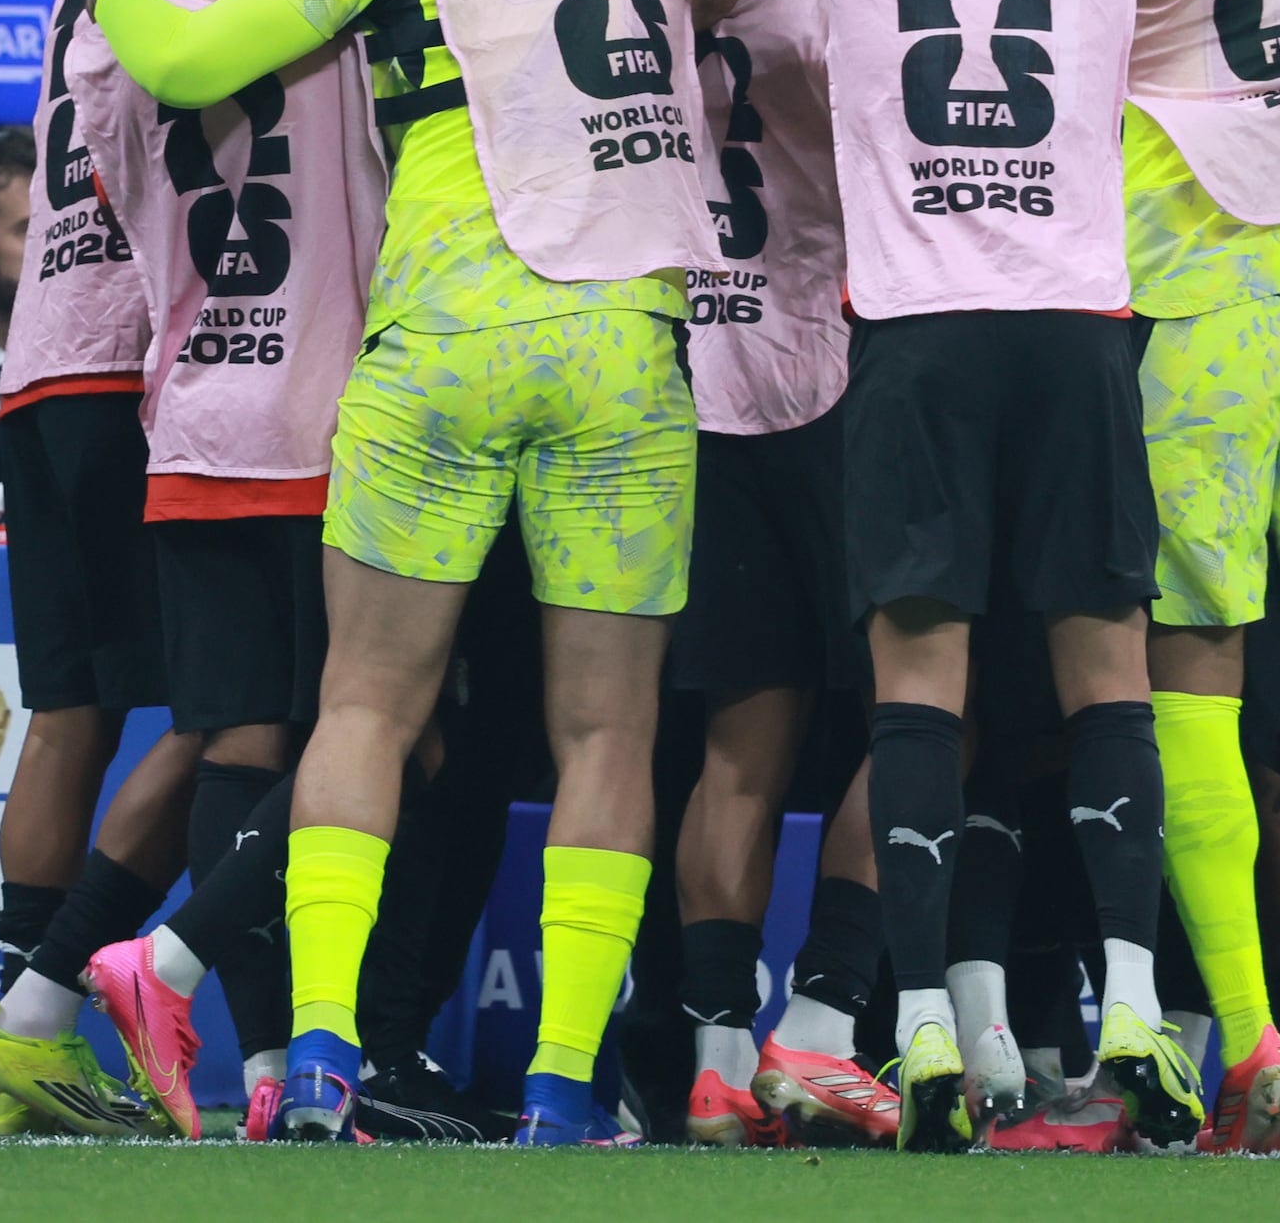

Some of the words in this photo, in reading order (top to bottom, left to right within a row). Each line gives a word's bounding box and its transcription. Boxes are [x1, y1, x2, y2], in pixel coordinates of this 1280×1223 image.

[606, 49, 662, 77] FIFA
[946, 101, 1016, 128] FIFA
[910, 157, 999, 182] WORLD
[1004, 158, 1055, 181] CUP
[911, 181, 1055, 217] 2026
[249, 307, 287, 327] CUP
